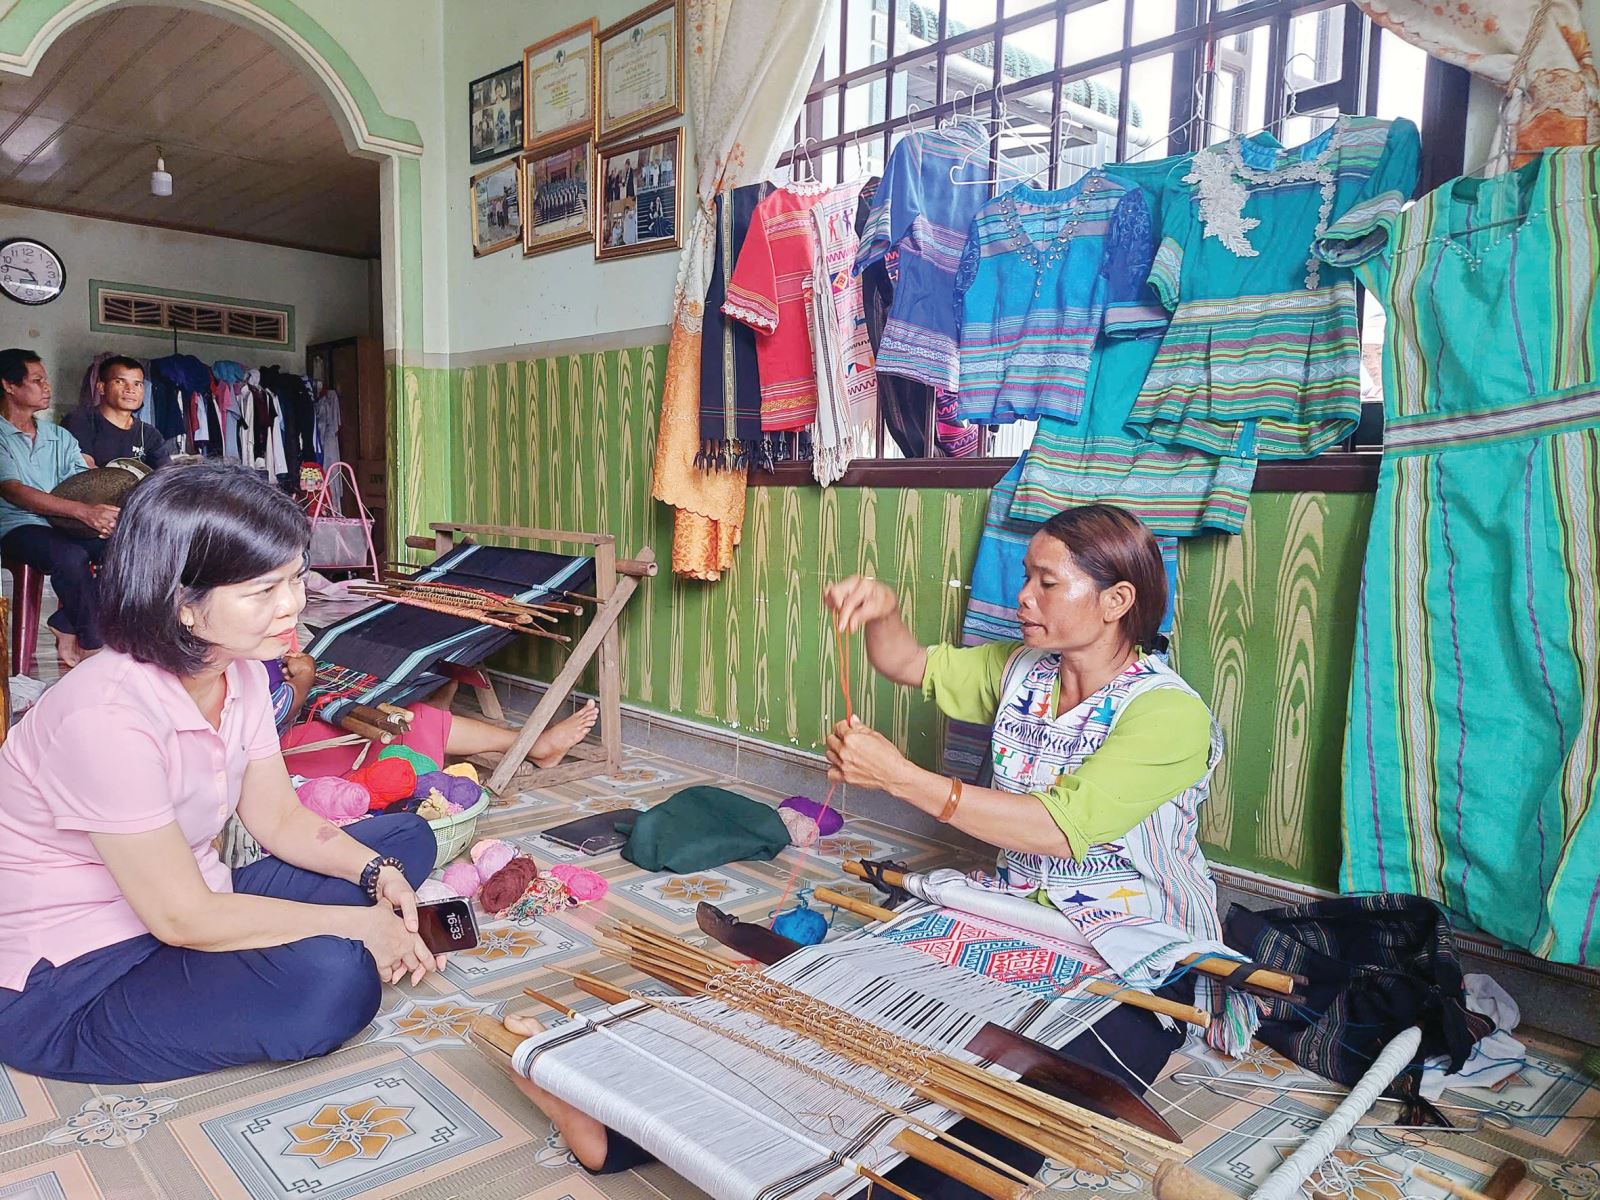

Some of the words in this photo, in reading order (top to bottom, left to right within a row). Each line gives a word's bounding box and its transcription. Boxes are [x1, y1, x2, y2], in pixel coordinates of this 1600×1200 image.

[22, 248, 34, 257] 12
[3, 256, 12, 264] 10
[0, 265, 9, 273] 9
[46, 261, 53, 269] 2
[47, 271, 56, 279] 3
[25, 288, 34, 297] 6
[446, 912, 462, 940] 16:33
